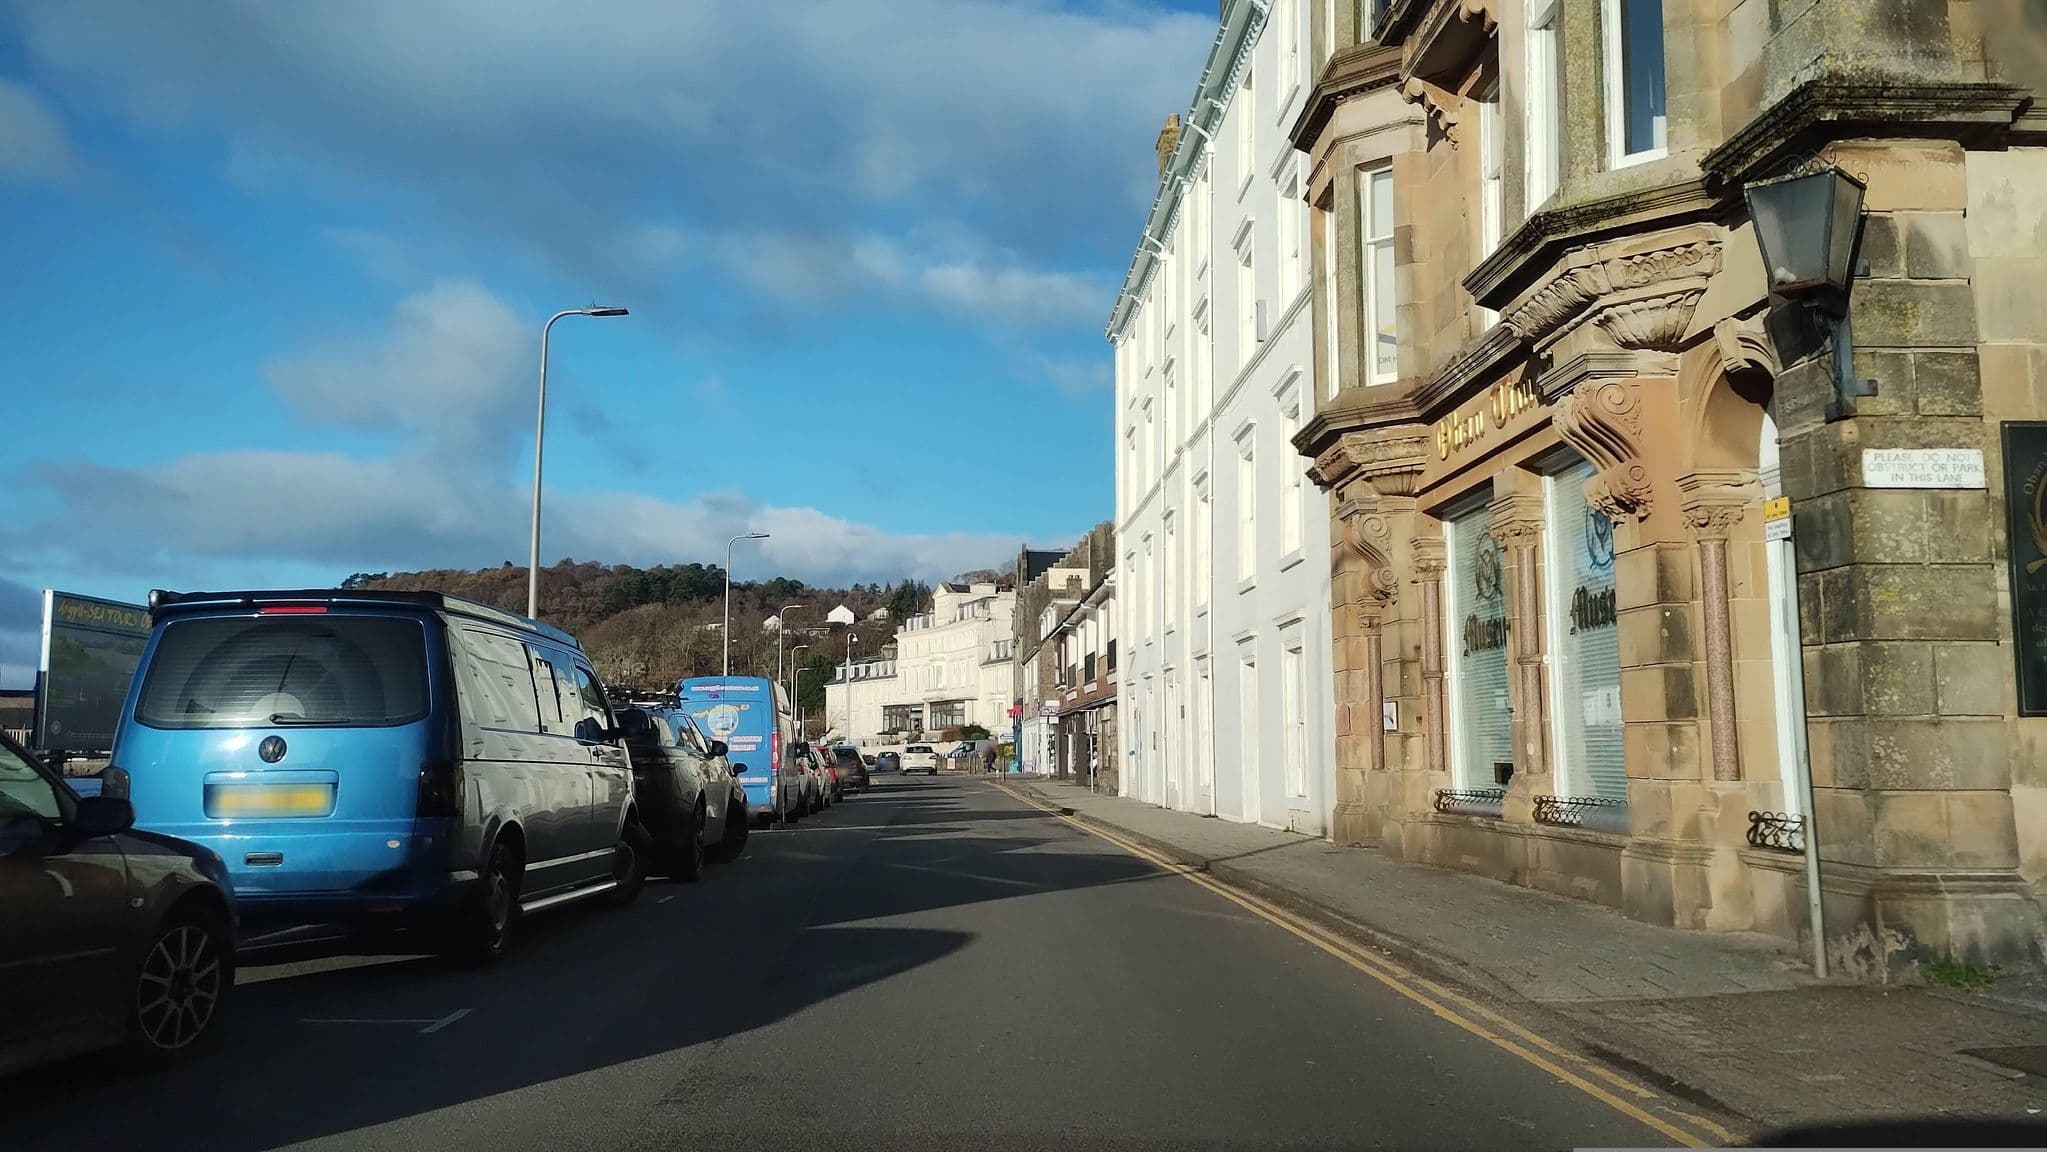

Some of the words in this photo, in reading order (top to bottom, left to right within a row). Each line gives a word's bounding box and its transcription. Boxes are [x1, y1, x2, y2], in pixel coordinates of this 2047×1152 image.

[1873, 452, 1912, 463] PLEASE
[1921, 452, 1940, 463] DO
[1946, 452, 1971, 463] NOT
[1867, 462, 1925, 473] OBSTRUCT
[1931, 463, 1945, 473] OR
[1952, 463, 1980, 473] PARK
[1891, 473, 1904, 482] IN
[1908, 473, 1933, 482] THIS
[1937, 473, 1963, 483] LANE
